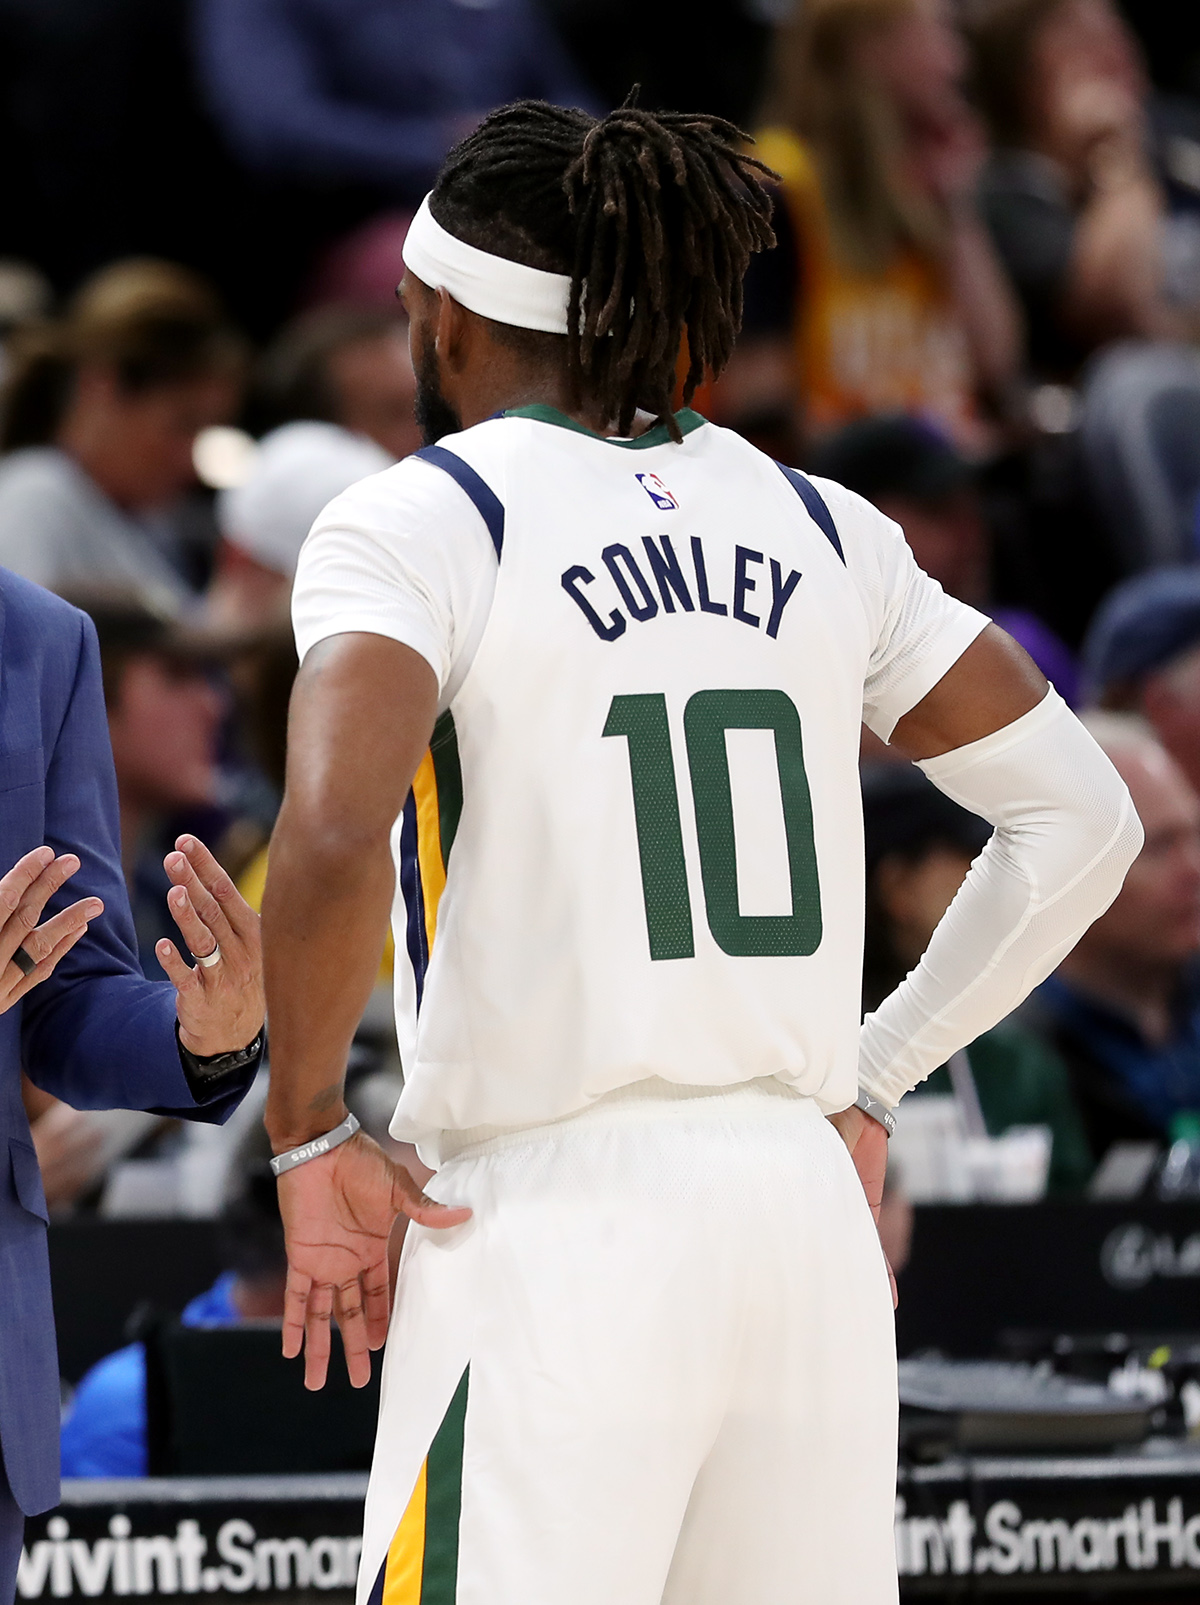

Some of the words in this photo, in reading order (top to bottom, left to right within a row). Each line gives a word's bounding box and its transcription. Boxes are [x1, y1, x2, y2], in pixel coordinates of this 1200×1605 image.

[561, 535, 802, 642] CONLEY
[601, 689, 823, 961] 10
[291, 1138, 331, 1162] Myles
